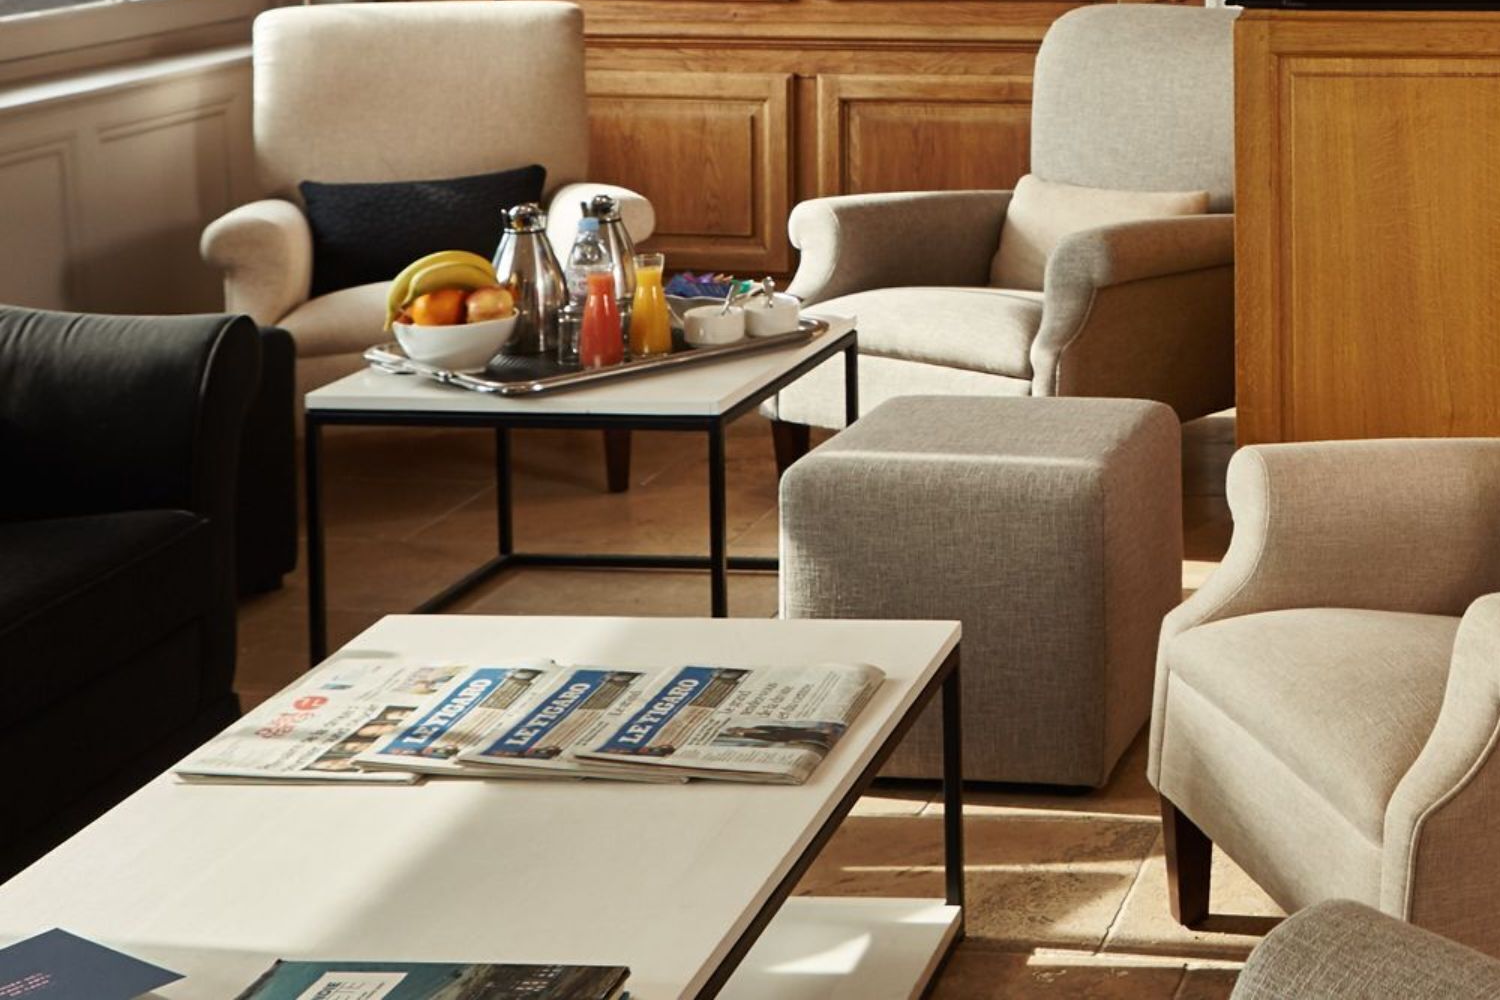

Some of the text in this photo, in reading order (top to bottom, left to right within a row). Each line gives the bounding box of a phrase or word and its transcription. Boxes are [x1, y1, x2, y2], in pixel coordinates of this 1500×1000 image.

[403, 722, 435, 744] LE
[505, 724, 536, 746] LE
[531, 683, 591, 727] FIGARO
[618, 724, 652, 744] LE
[639, 679, 699, 723] FIGARO
